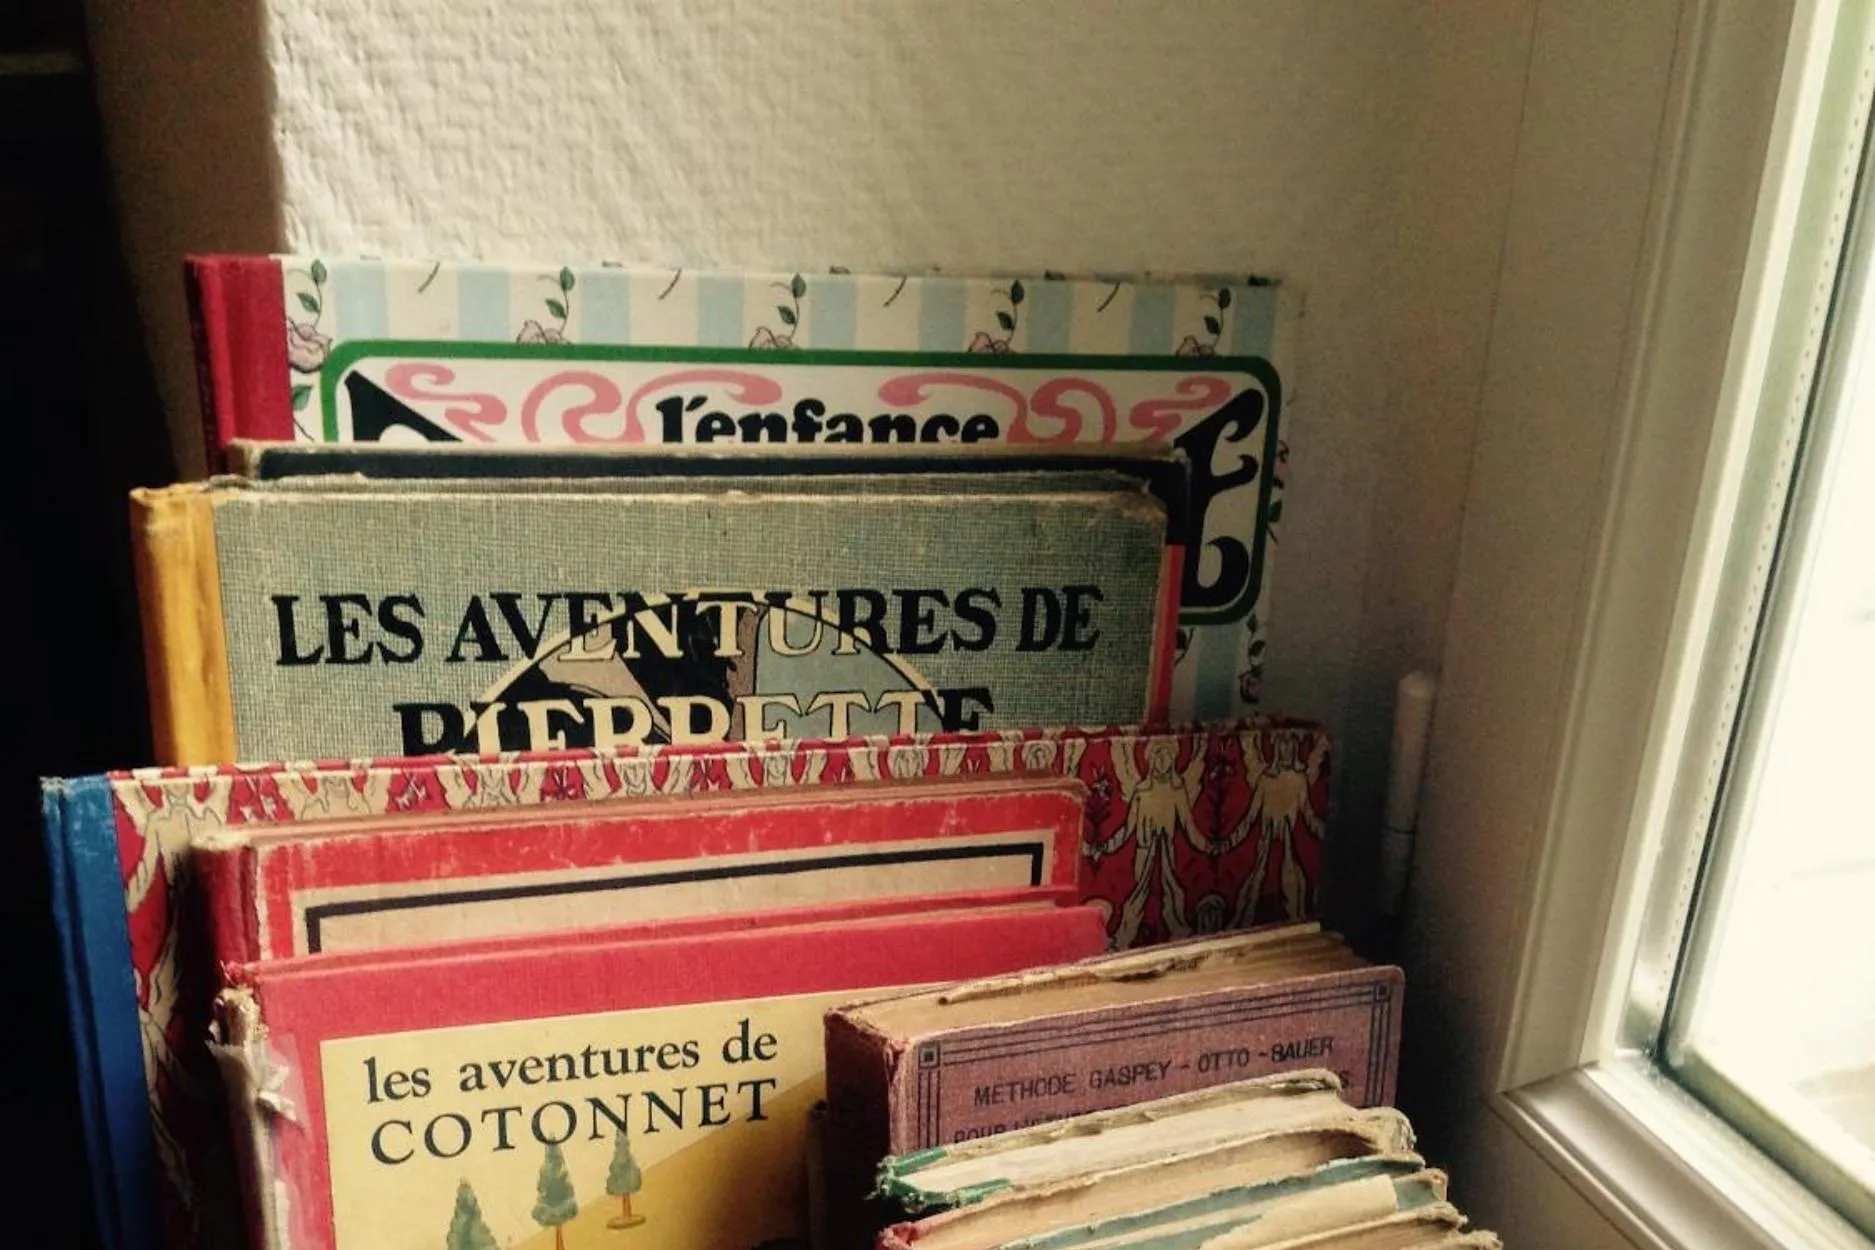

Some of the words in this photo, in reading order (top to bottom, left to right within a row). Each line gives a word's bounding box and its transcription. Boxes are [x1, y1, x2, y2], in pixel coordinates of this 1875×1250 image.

[271, 593, 425, 666] LES
[446, 585, 1002, 664] AVENTURES
[1015, 584, 1103, 652] DE
[363, 1056, 431, 1104] les
[459, 1037, 700, 1094] aventures
[722, 1018, 778, 1065] de
[1088, 1059, 1172, 1090] GASPEY
[1198, 1047, 1249, 1074] OTTO
[371, 1078, 778, 1166] COTONNET
